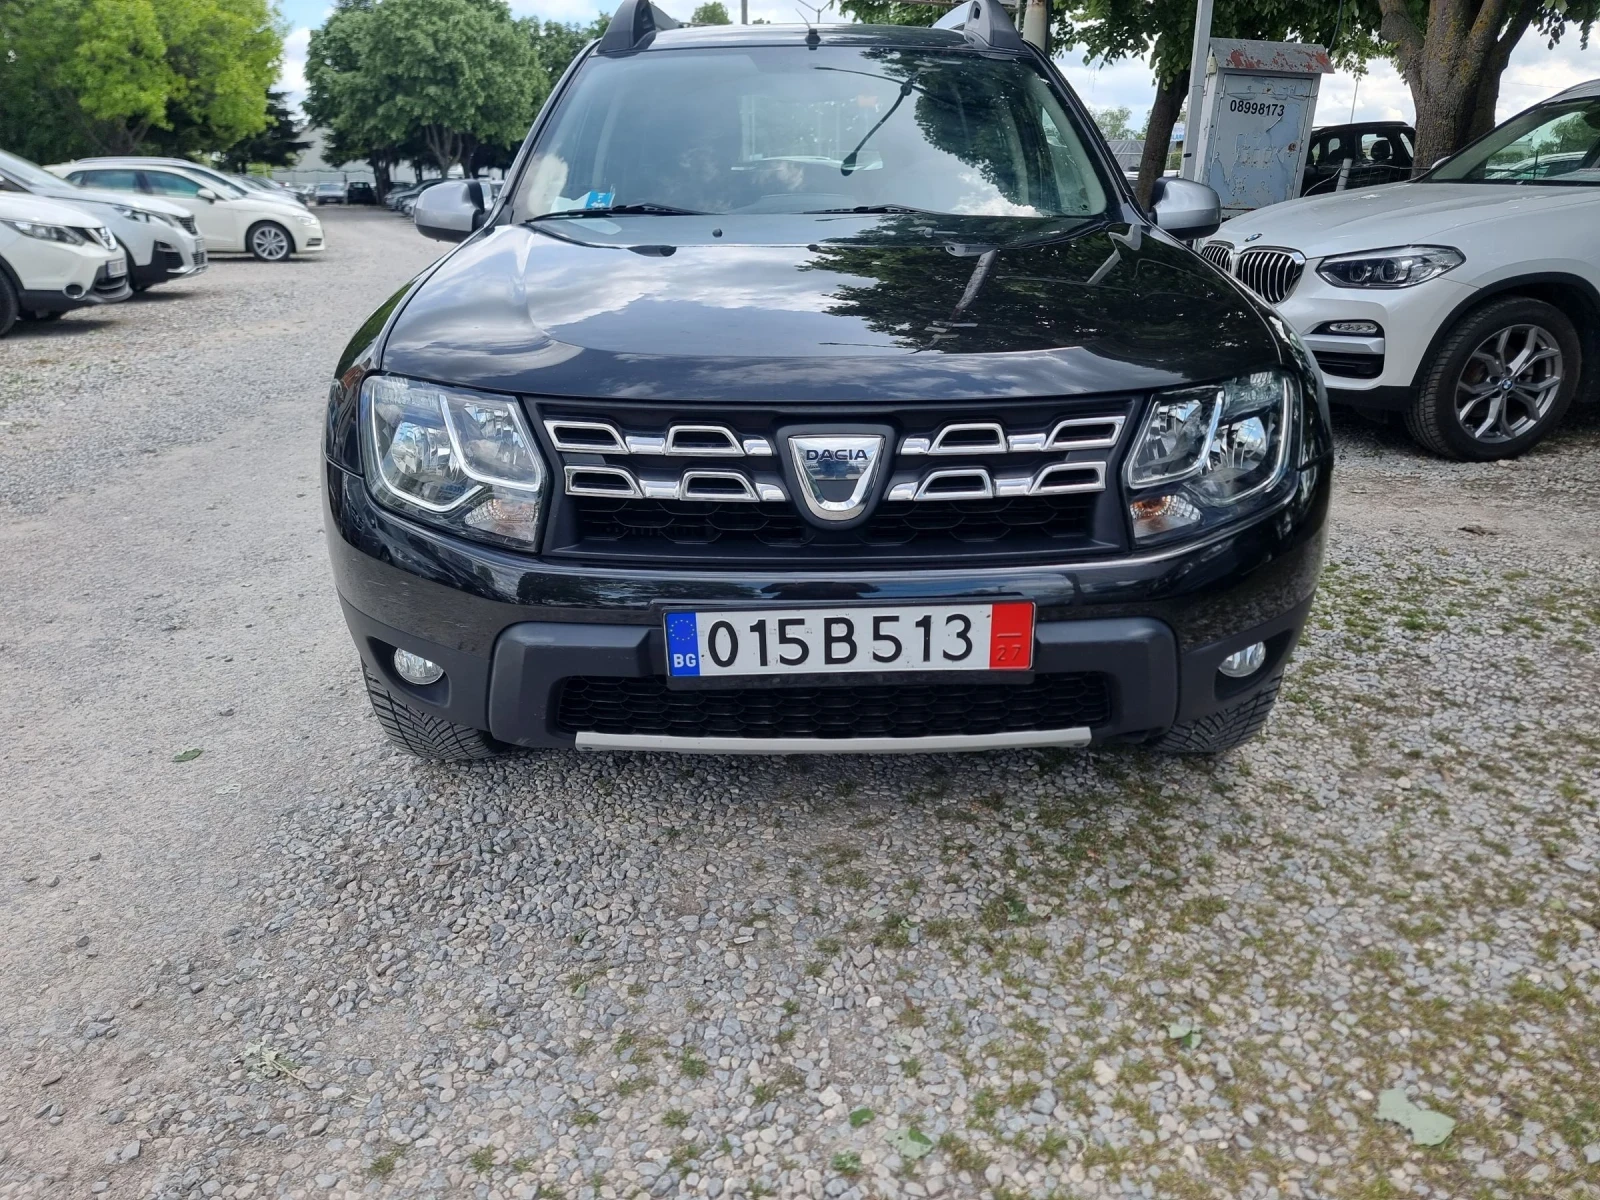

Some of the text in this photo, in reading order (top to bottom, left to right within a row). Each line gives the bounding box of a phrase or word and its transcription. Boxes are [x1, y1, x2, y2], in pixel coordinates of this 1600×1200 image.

[1230, 100, 1284, 116] 08998173
[806, 449, 868, 460] DACIA
[707, 613, 973, 668] 015B513
[673, 653, 697, 668] BG
[996, 644, 1021, 661] 27
